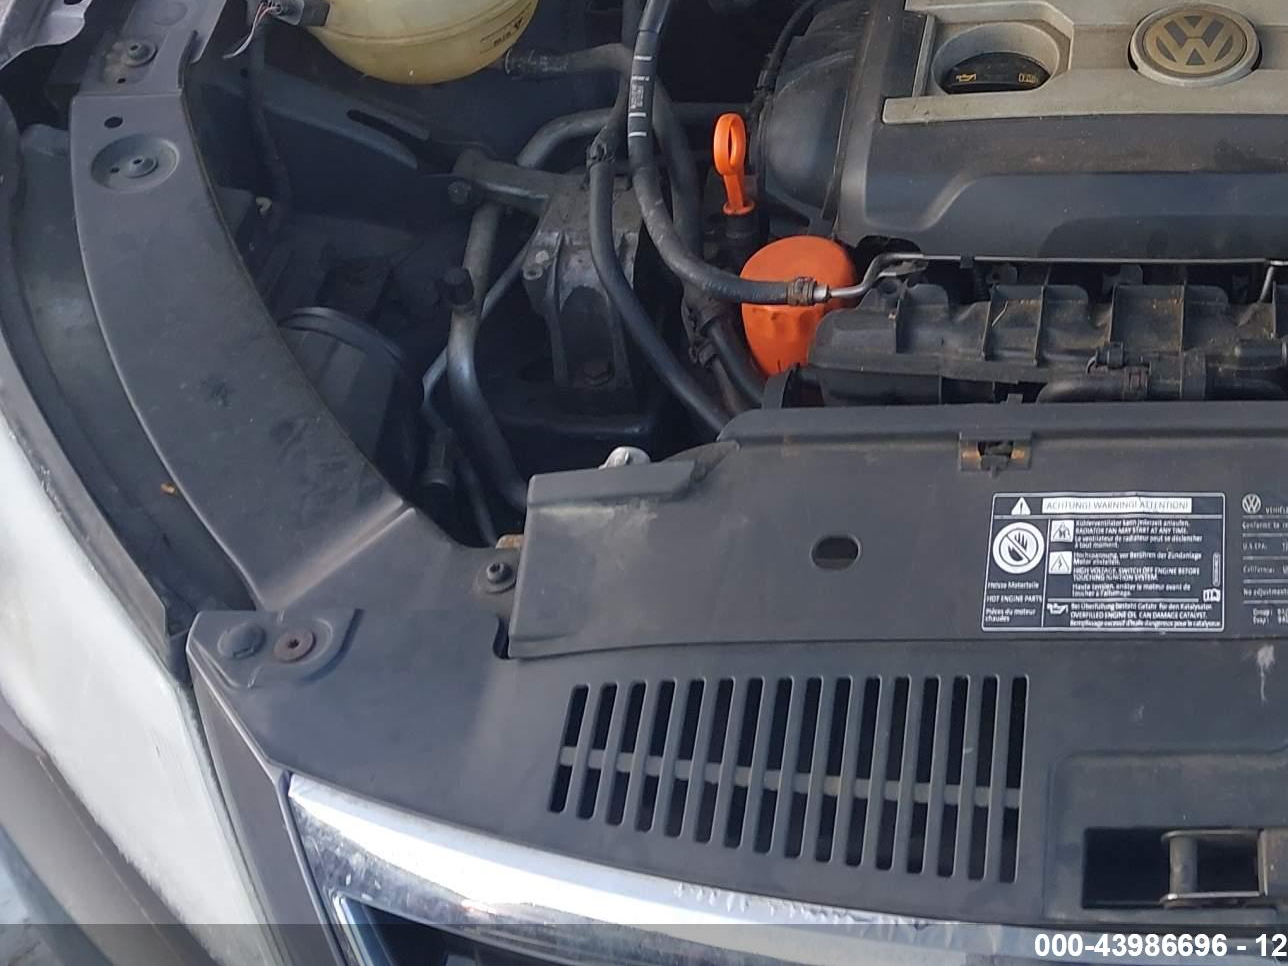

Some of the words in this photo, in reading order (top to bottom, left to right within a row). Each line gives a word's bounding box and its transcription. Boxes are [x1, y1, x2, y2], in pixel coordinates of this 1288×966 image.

[1093, 501, 1137, 510] WARNING!
[1139, 500, 1189, 510] ATTENTION!
[1273, 521, 1280, 529] to
[986, 595, 1000, 603] HOT
[1070, 611, 1104, 619] OVERFILLED
[1104, 611, 1126, 619] ENGINE
[1139, 611, 1152, 619] CAN
[1152, 611, 1178, 619] DAMAGE
